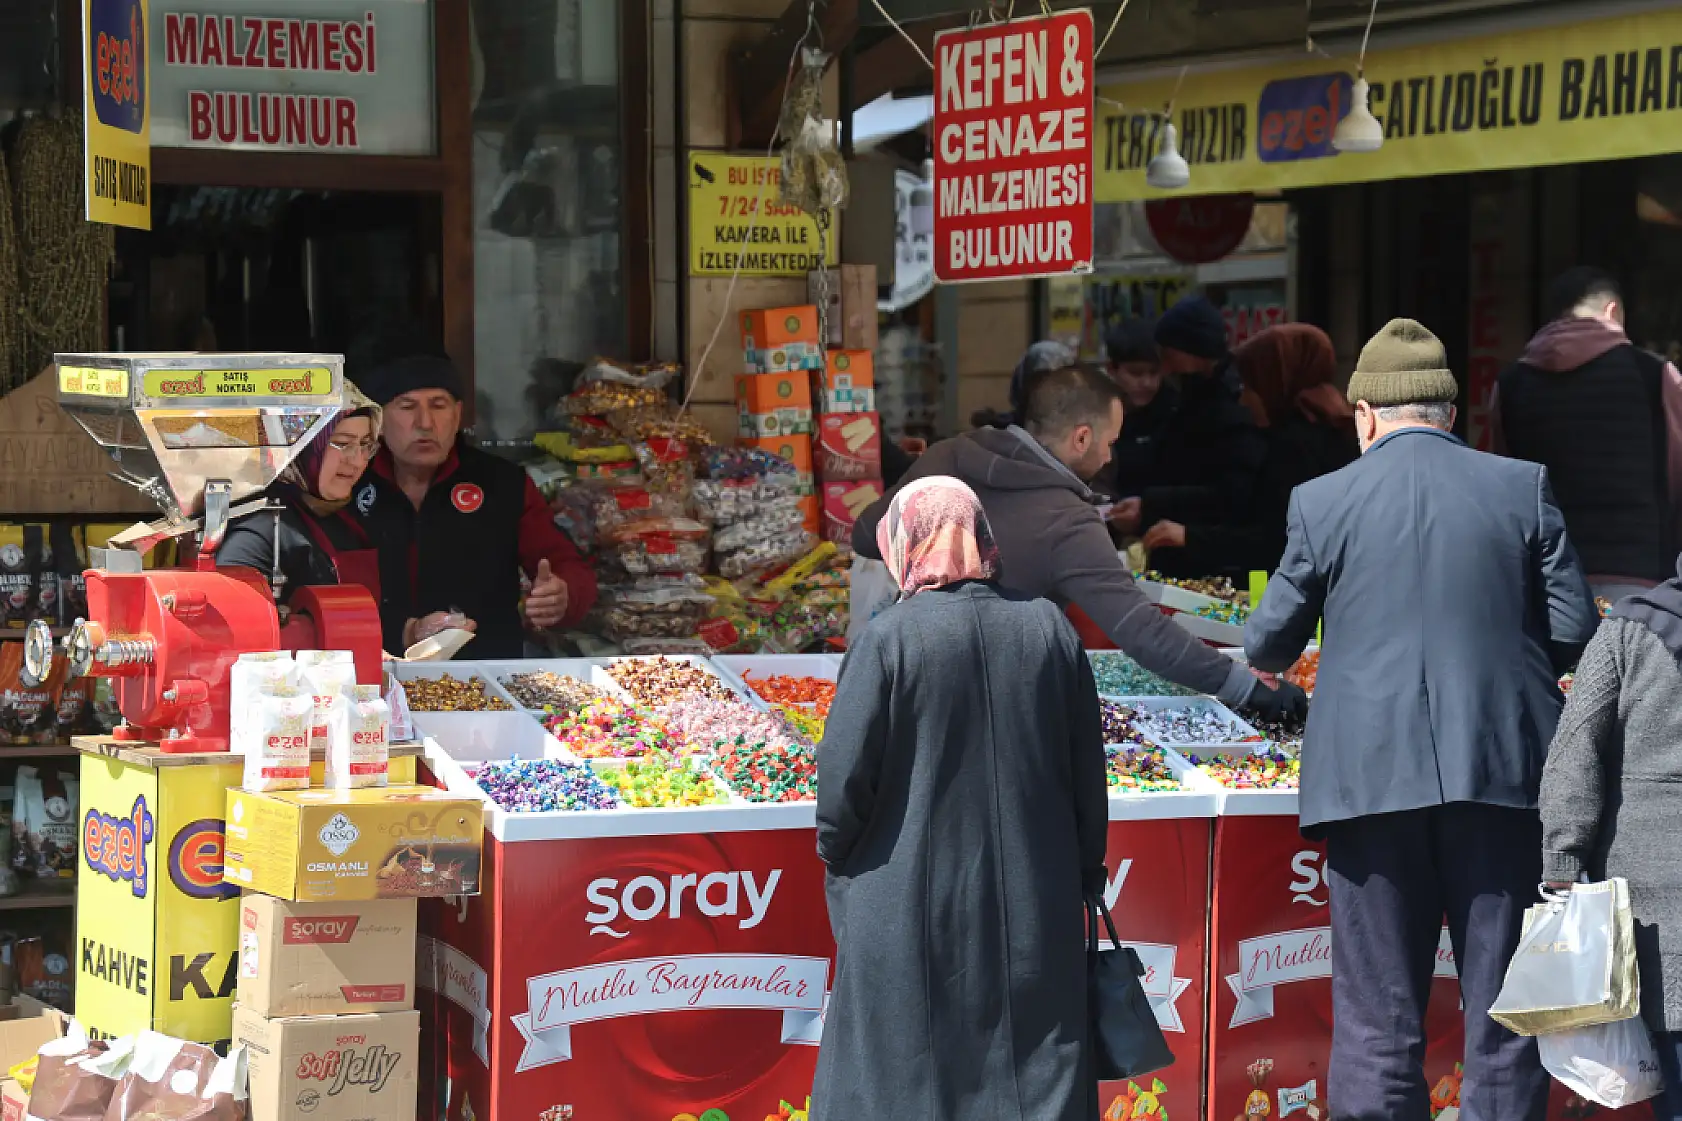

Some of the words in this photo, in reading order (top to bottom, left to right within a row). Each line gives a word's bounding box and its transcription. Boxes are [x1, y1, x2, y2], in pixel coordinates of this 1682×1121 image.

[97, 4, 137, 104] ezel
[165, 13, 376, 73] MALZEMESİ
[940, 29, 1048, 113] KEFEN
[1060, 24, 1085, 97] &
[188, 91, 358, 147] BULUNUR
[940, 107, 1086, 164] CENAZE
[1180, 102, 1247, 165] HIZIR
[1261, 77, 1341, 150] ezel
[728, 165, 748, 184] BU
[939, 163, 1086, 218] MALZEMESİ
[715, 225, 781, 243] KAMERA
[785, 221, 808, 243] İLE
[949, 220, 1073, 270] BULUNUR
[160, 369, 206, 394] ezel
[216, 383, 257, 394] NOKTASI
[222, 371, 250, 383] SATIŞ
[268, 371, 313, 393] ezel
[267, 727, 310, 749] ezel
[352, 725, 386, 745] ezel
[86, 797, 146, 877] ezel
[306, 861, 369, 873] OSMANLI
[82, 937, 149, 996] KAHVE
[538, 968, 640, 1022] Mutlu
[646, 961, 808, 1006] Bayramlar
[296, 1049, 340, 1081] Soft
[326, 1043, 402, 1096] Jelly
